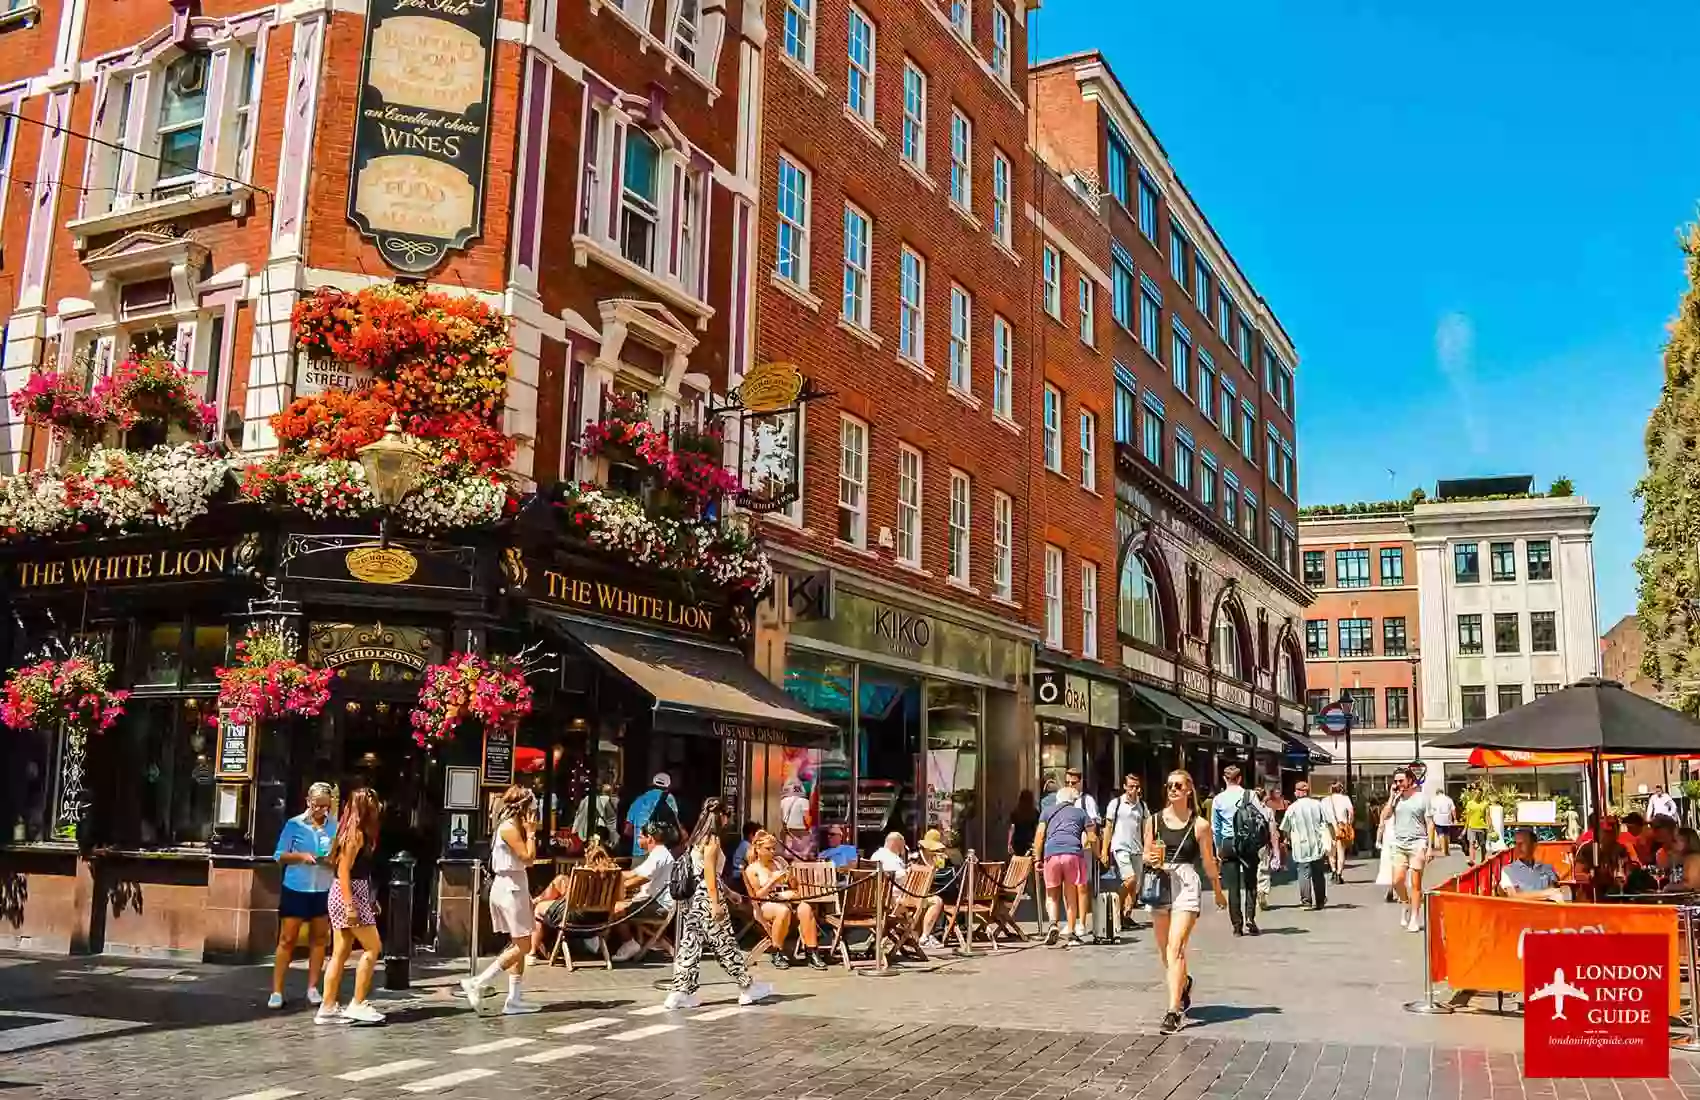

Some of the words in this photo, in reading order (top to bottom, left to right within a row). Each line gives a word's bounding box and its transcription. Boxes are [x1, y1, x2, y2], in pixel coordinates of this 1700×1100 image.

[364, 108, 384, 119] an
[384, 105, 446, 128] Excellent
[444, 118, 480, 135] choice
[414, 126, 429, 136] of
[380, 122, 460, 158] WINES
[305, 372, 352, 388] STREET
[18, 561, 64, 587] THE
[71, 553, 152, 583] WHITE
[159, 548, 226, 576] LION
[544, 570, 591, 605] THE
[596, 581, 663, 620] WHITE
[667, 600, 712, 631] LION
[873, 606, 930, 647] KIKO
[326, 649, 424, 668] NICHOLSON'S
